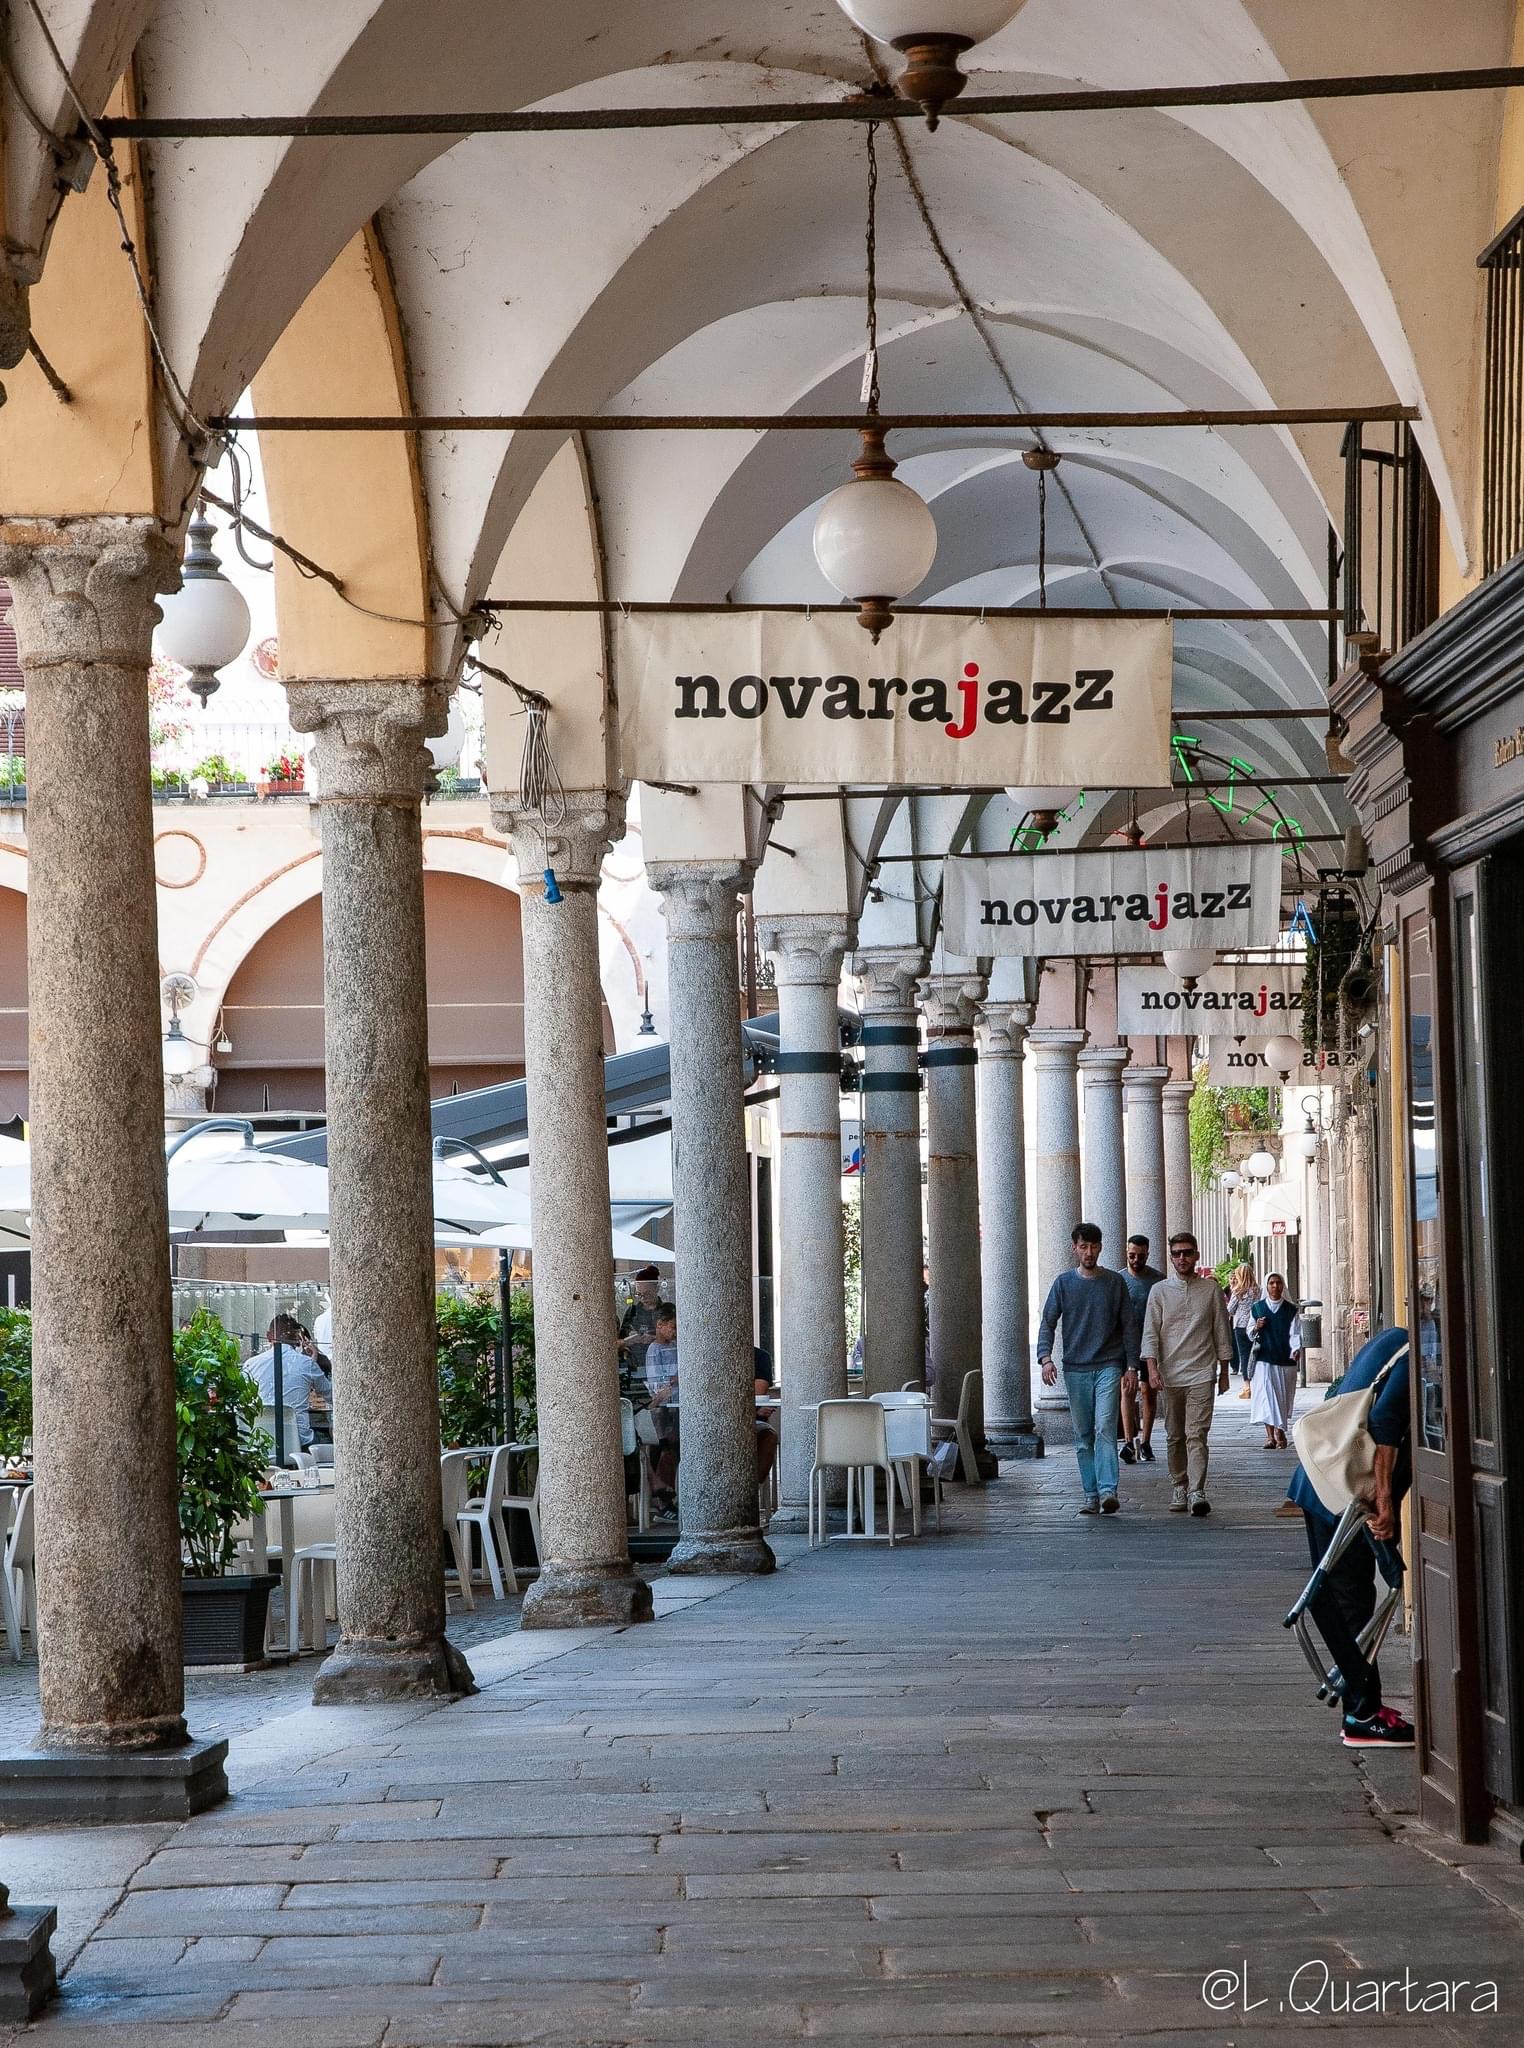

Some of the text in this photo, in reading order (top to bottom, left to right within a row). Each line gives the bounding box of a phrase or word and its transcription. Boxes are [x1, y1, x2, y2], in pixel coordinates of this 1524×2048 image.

[675, 662, 1114, 739] novarajazz
[981, 883, 1252, 930] novarajazz
[1141, 984, 1304, 1017] novarajaz
